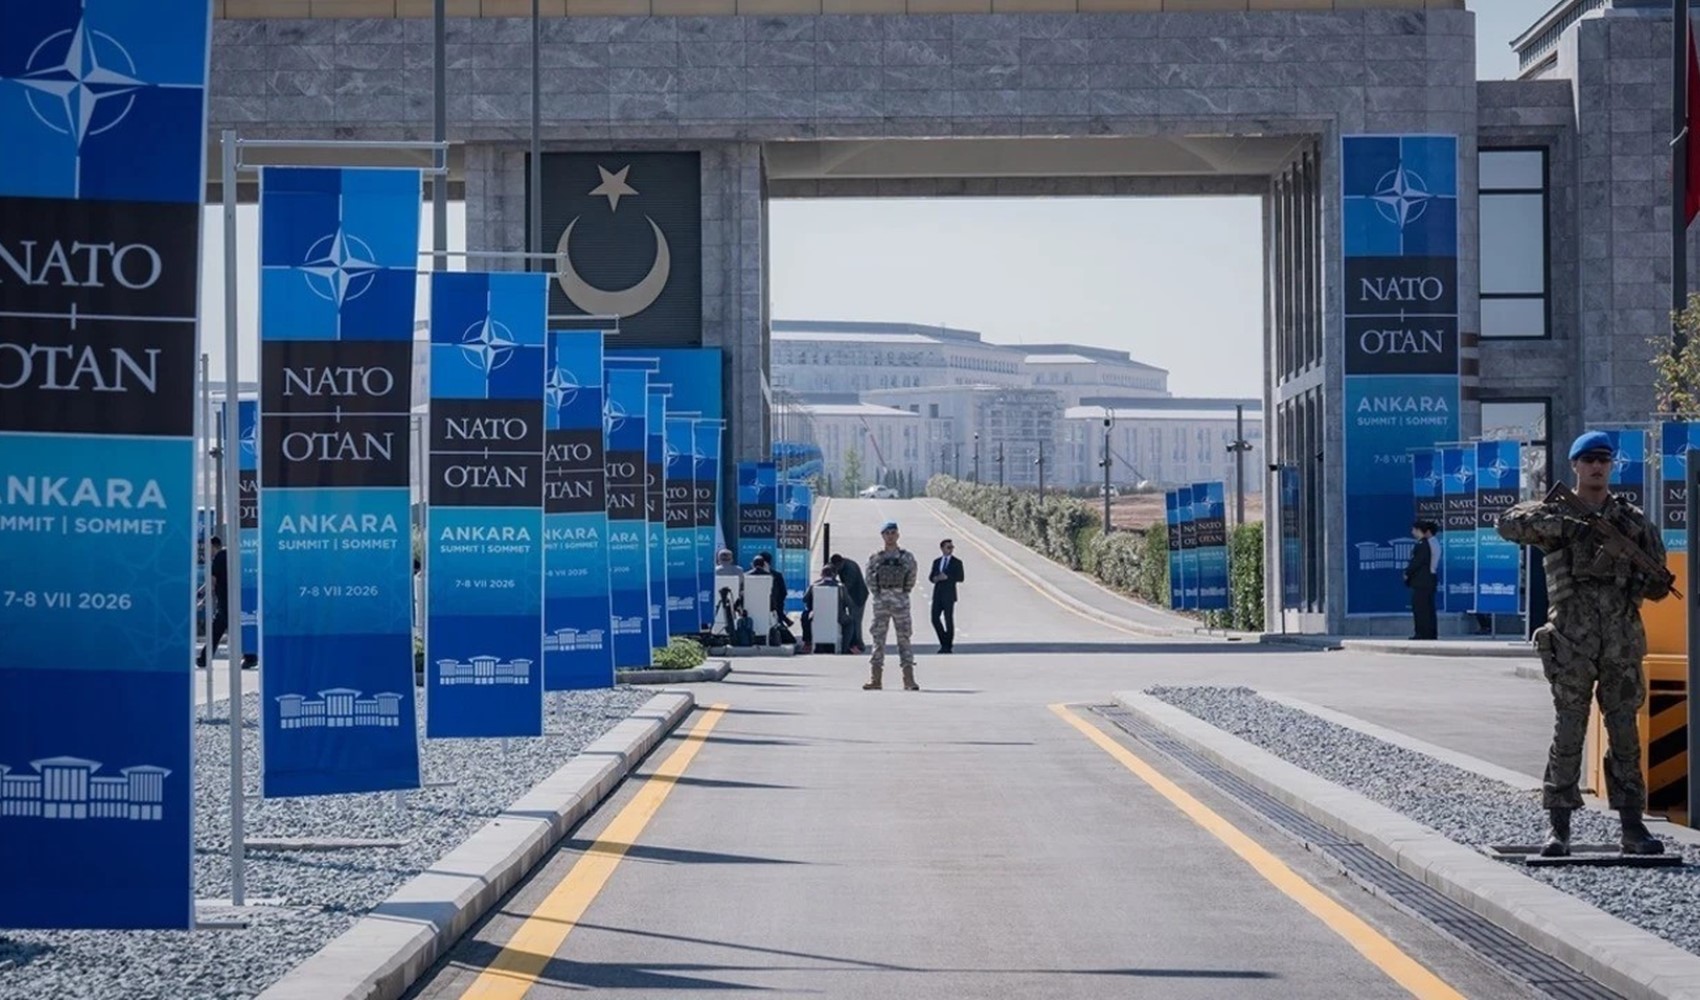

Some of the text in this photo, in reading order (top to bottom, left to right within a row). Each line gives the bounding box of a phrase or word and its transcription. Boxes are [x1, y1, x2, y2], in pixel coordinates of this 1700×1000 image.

[0, 239, 162, 289] NATO
[1360, 277, 1443, 301] NATO
[1360, 329, 1444, 354] OTAN
[0, 343, 161, 393] OTAN
[283, 366, 394, 396] NATO
[1357, 397, 1449, 412] ANKARA
[445, 418, 528, 440] NATO
[1357, 416, 1448, 426] SUMMIT SOMMET
[282, 432, 394, 461] OTAN
[545, 444, 592, 462] ATO
[1373, 455, 1390, 464] 7-8
[444, 465, 528, 488] OTAN
[604, 462, 636, 478] TO
[0, 475, 167, 509] NKARA
[545, 481, 593, 499] TAN
[1483, 494, 1515, 504] NATO
[605, 493, 636, 508] AN
[744, 509, 772, 518] NATO
[0, 515, 166, 535] MMIT SOMMET
[278, 514, 398, 534] ANKARA
[440, 526, 531, 541] ANKARA
[609, 532, 639, 543] ARA
[278, 539, 398, 550] SUMMIT SOMMET
[440, 544, 531, 553] SUMMIT SOMMET
[300, 586, 378, 597] 7-8 VII 2026
[455, 580, 472, 588] 7-8
[490, 580, 515, 588] 2026
[4, 590, 132, 609] 7-8 VII 2026
